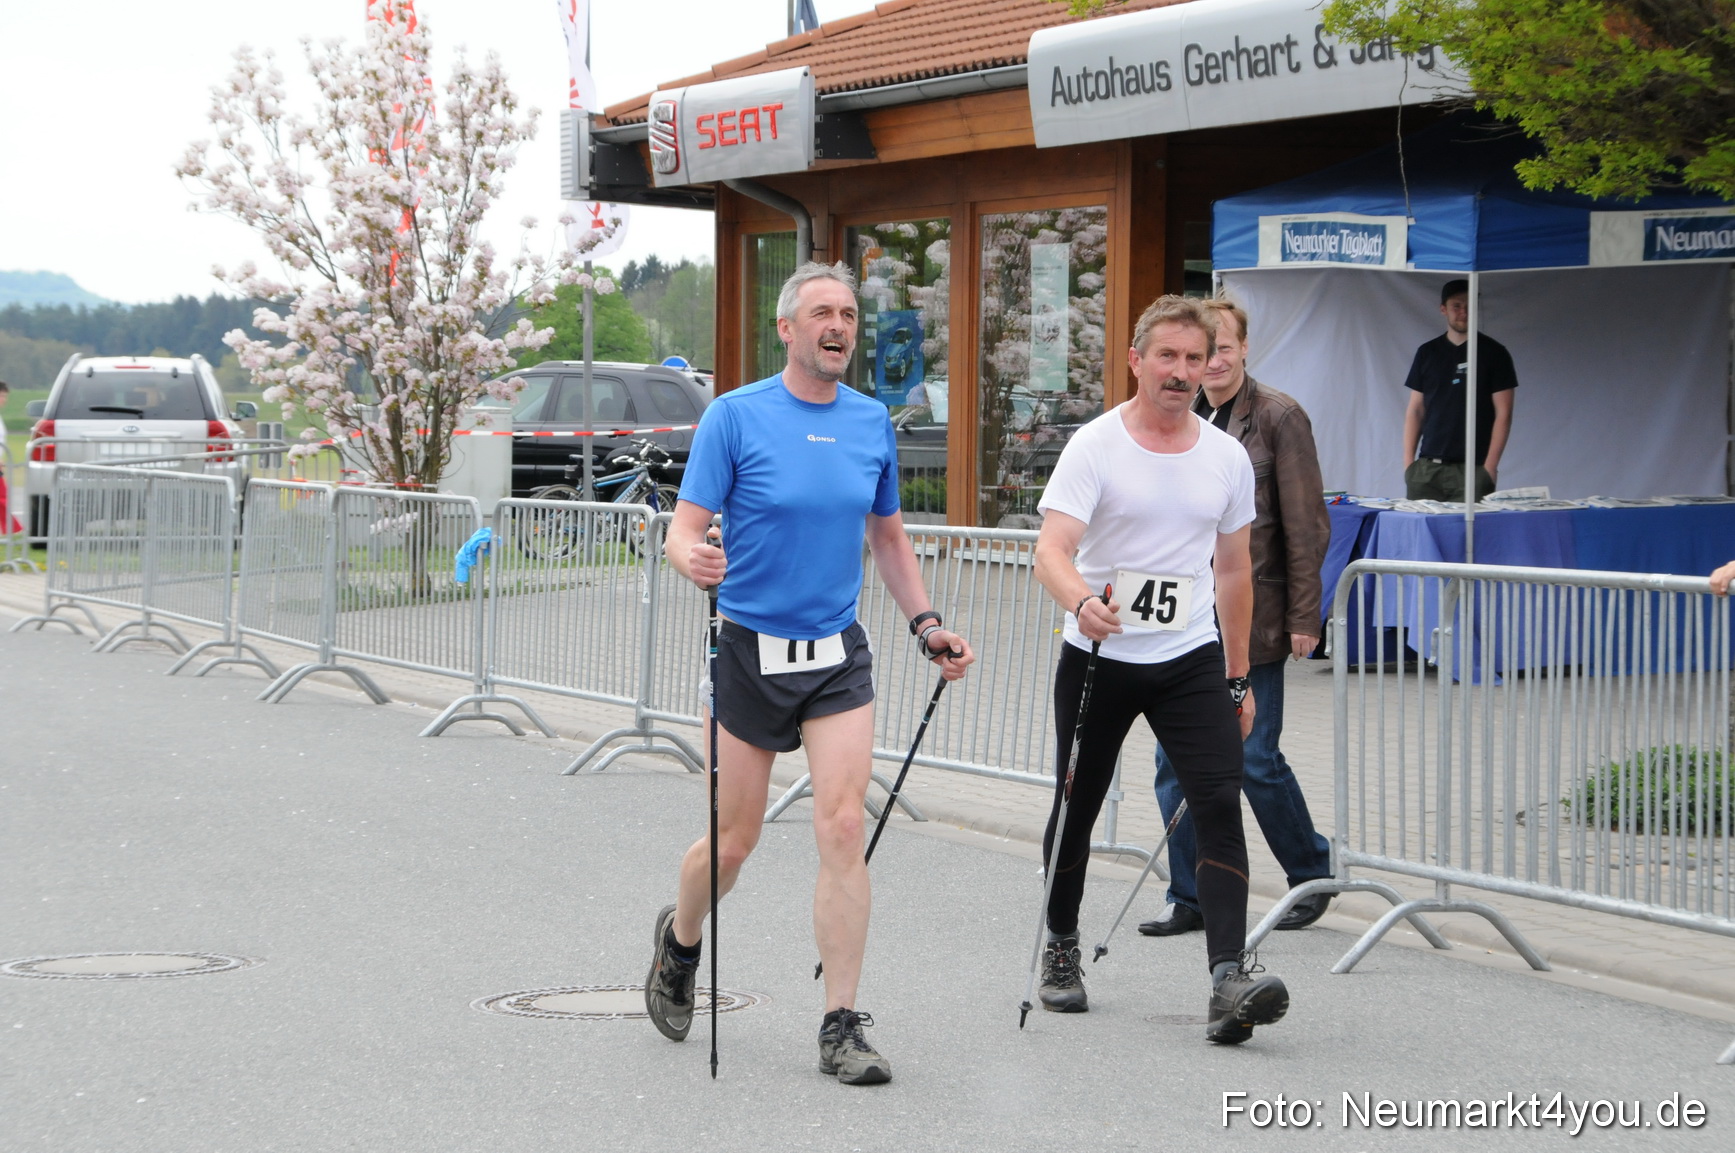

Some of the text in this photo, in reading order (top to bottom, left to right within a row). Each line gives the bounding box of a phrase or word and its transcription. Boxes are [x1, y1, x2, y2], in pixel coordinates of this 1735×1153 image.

[1051, 56, 1172, 107] Autohaus
[1184, 33, 1301, 87] Gerhart
[1313, 23, 1338, 69] &
[696, 102, 784, 150] SEAT
[1340, 229, 1383, 258] Tagblatt
[1130, 579, 1178, 625] 45
[1234, 680, 1242, 702] LEKI
